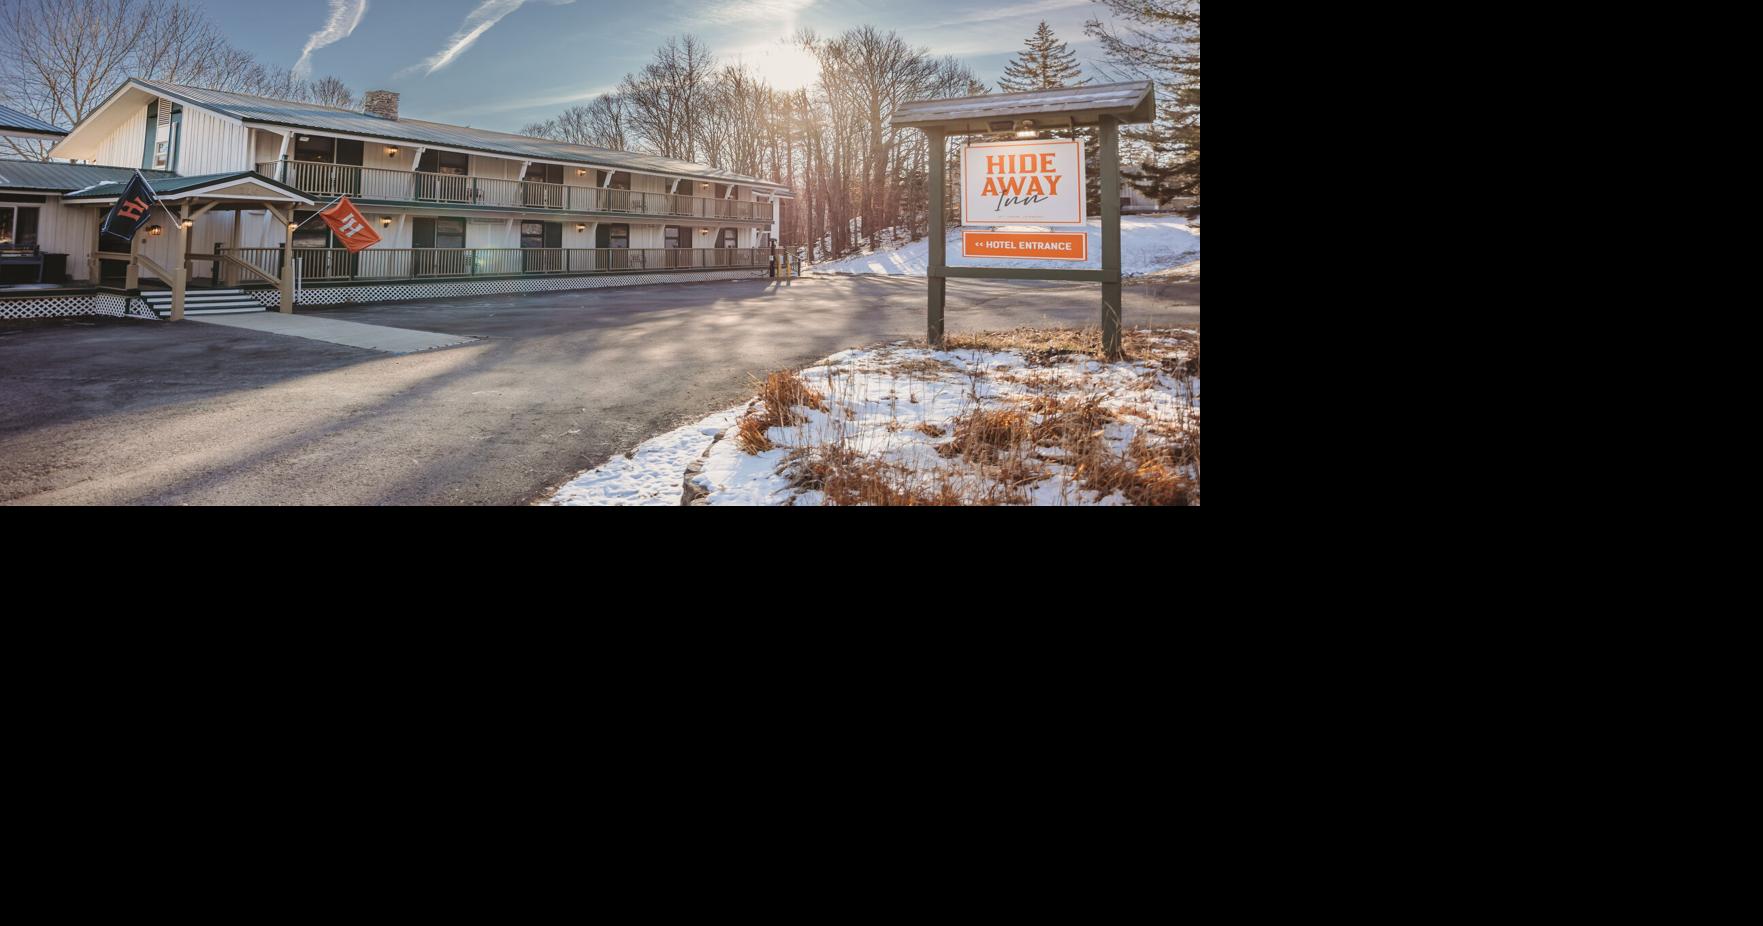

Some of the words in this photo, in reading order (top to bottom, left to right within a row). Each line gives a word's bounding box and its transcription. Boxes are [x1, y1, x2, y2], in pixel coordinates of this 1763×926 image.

[985, 153, 1057, 175] HIDE
[981, 175, 1062, 197] AWAY
[994, 189, 1049, 212] Inn
[985, 240, 1016, 250] HOTEL
[1018, 241, 1073, 251] ENTRANCE
